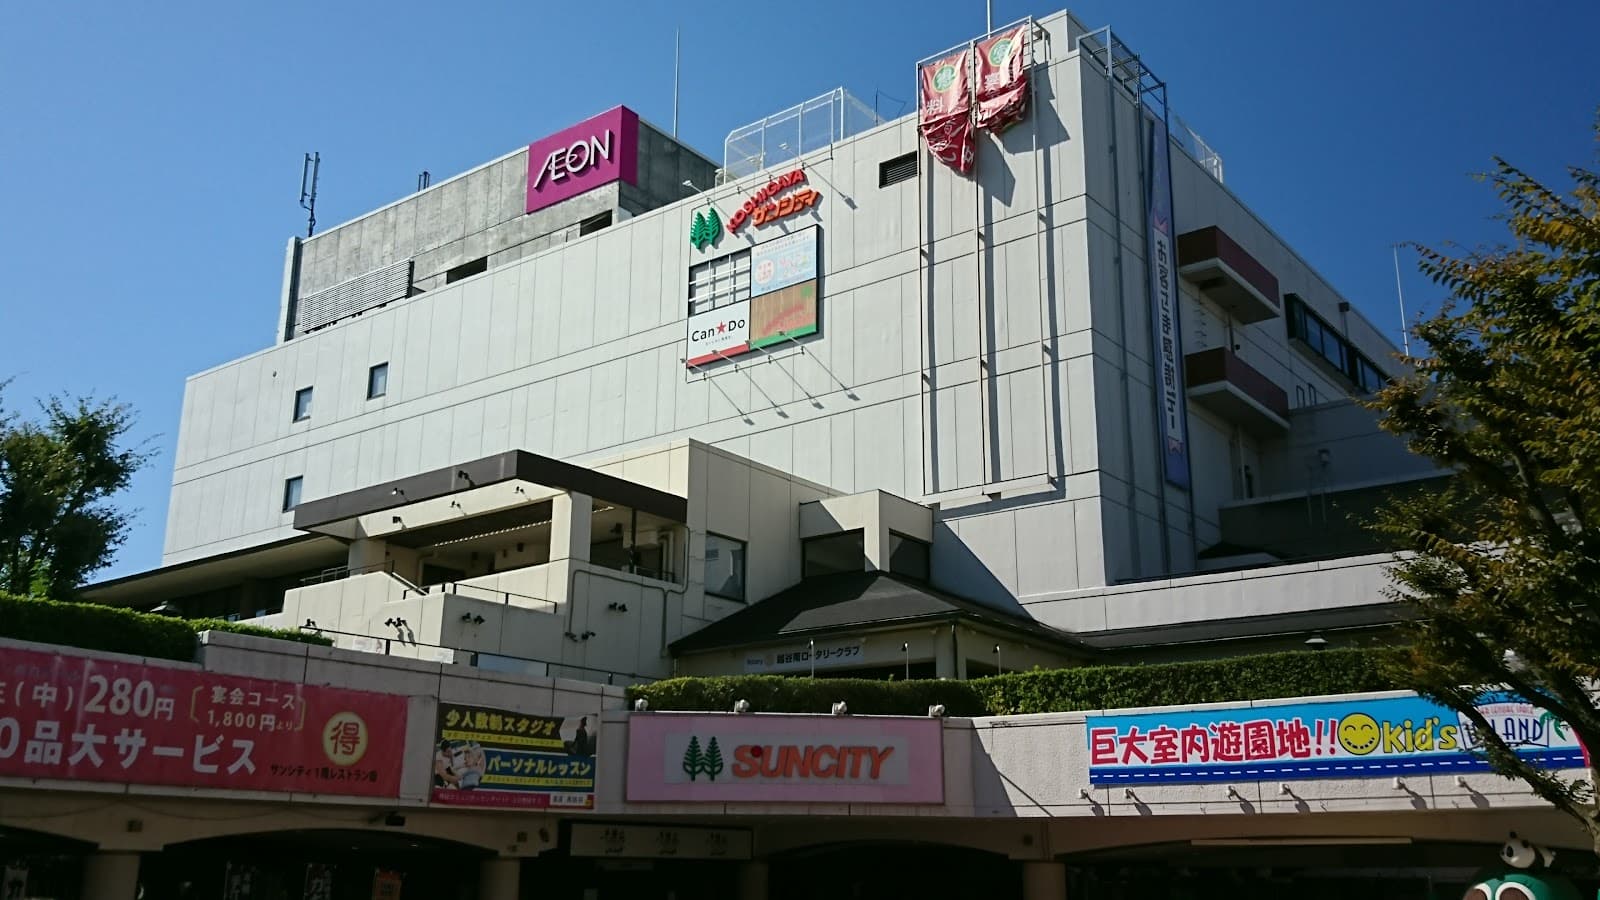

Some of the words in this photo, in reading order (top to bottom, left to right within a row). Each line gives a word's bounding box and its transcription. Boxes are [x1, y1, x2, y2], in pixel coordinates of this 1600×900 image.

[726, 168, 805, 234] KOSHIGAYA
[752, 189, 820, 227] サンシティ
[211, 686, 296, 711] 宴会コース
[329, 720, 361, 756] 得
[487, 755, 592, 777] パーソナルレッスン
[732, 744, 895, 780] SUNCITY
